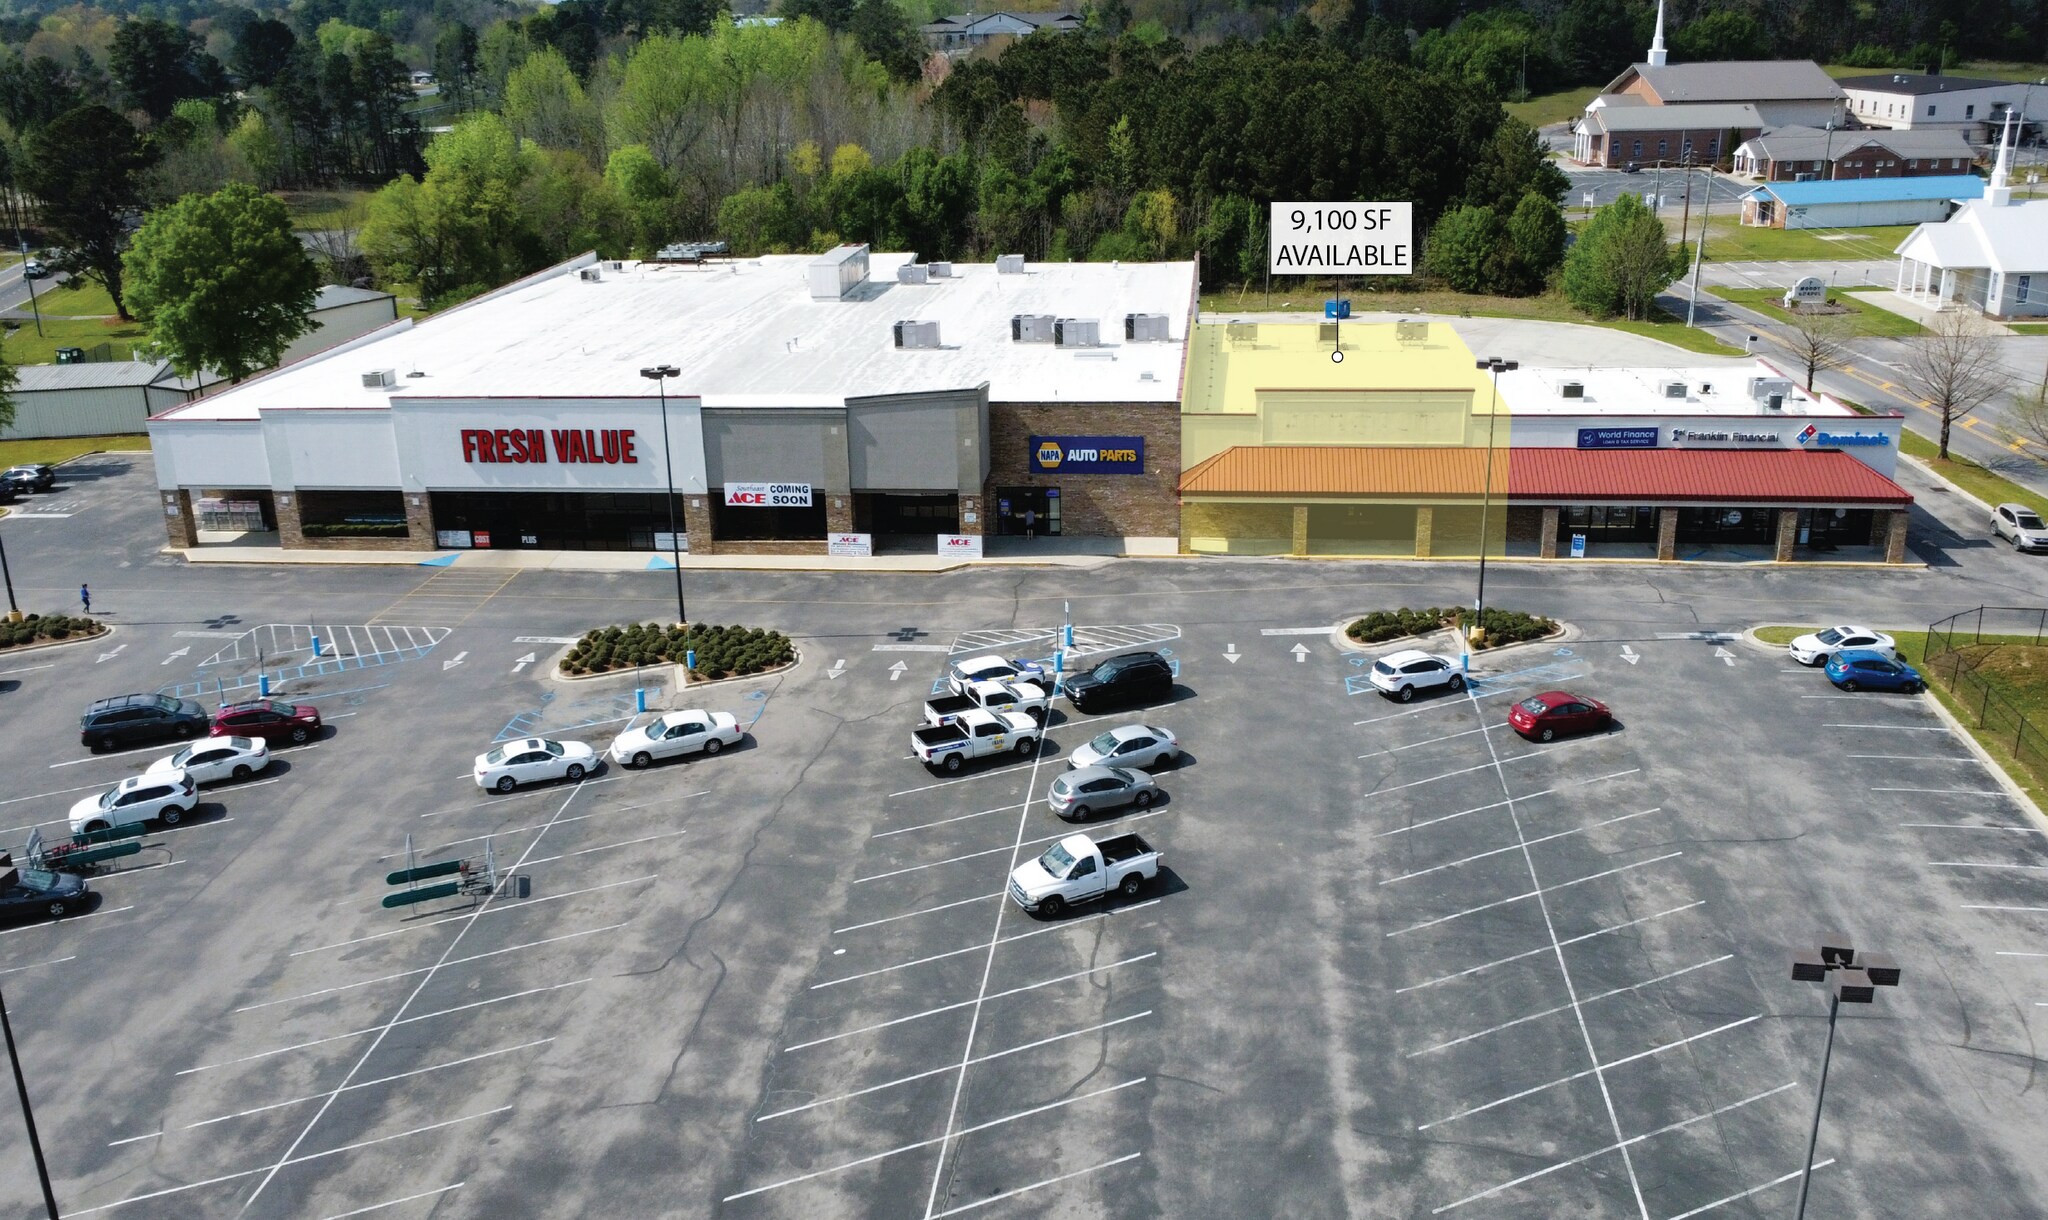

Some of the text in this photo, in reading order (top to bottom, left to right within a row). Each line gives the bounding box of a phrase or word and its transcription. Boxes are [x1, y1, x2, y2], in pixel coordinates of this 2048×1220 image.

[1598, 430, 1655, 439] World Finance
[1687, 431, 1728, 441] Franklin
[1731, 431, 1779, 442] Financial
[1817, 431, 1889, 446] Domino's
[460, 429, 638, 464] FRESH VALUE
[1040, 449, 1060, 461] NAPA
[1067, 449, 1137, 462] AUTO PARTS
[770, 485, 809, 494] COMING
[728, 491, 766, 504] ACE
[773, 495, 808, 504] SOON
[475, 535, 490, 543] COST
[521, 535, 537, 544] PLUS
[947, 538, 971, 546] ACE
